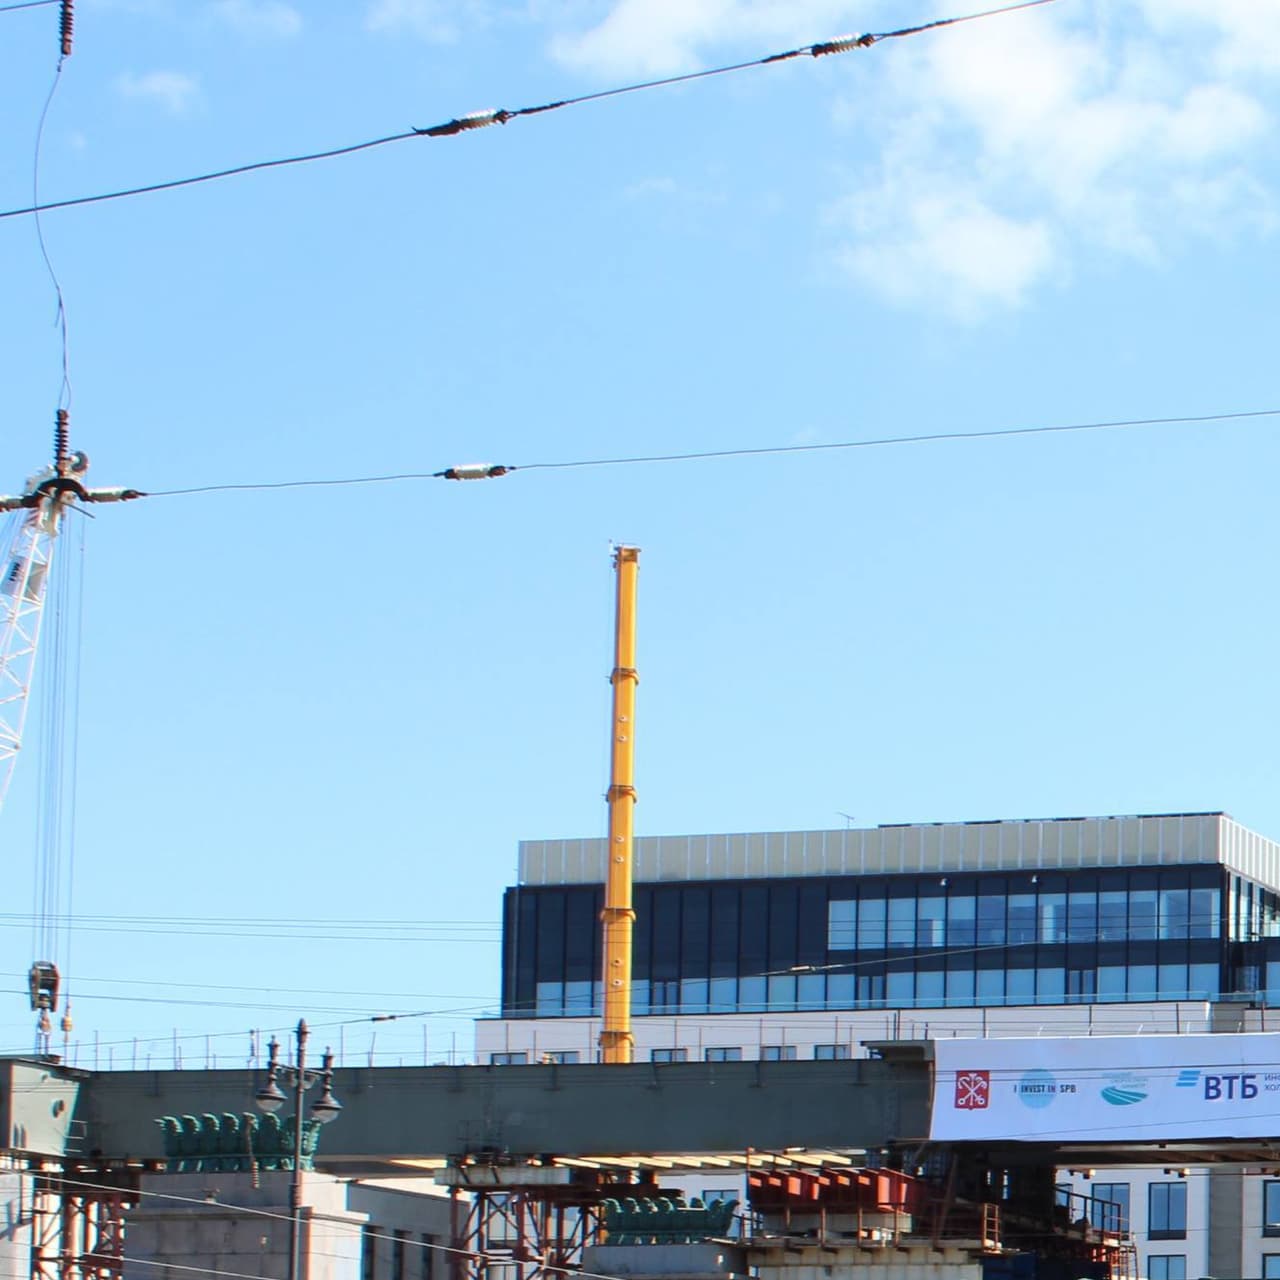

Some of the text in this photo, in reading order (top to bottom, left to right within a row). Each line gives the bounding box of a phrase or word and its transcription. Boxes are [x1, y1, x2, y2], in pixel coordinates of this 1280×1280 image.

[1020, 1084, 1046, 1094] INVEST
[1047, 1084, 1057, 1093] IN
[1059, 1084, 1077, 1093] SPB
[1204, 1075, 1258, 1100] ВТБ
